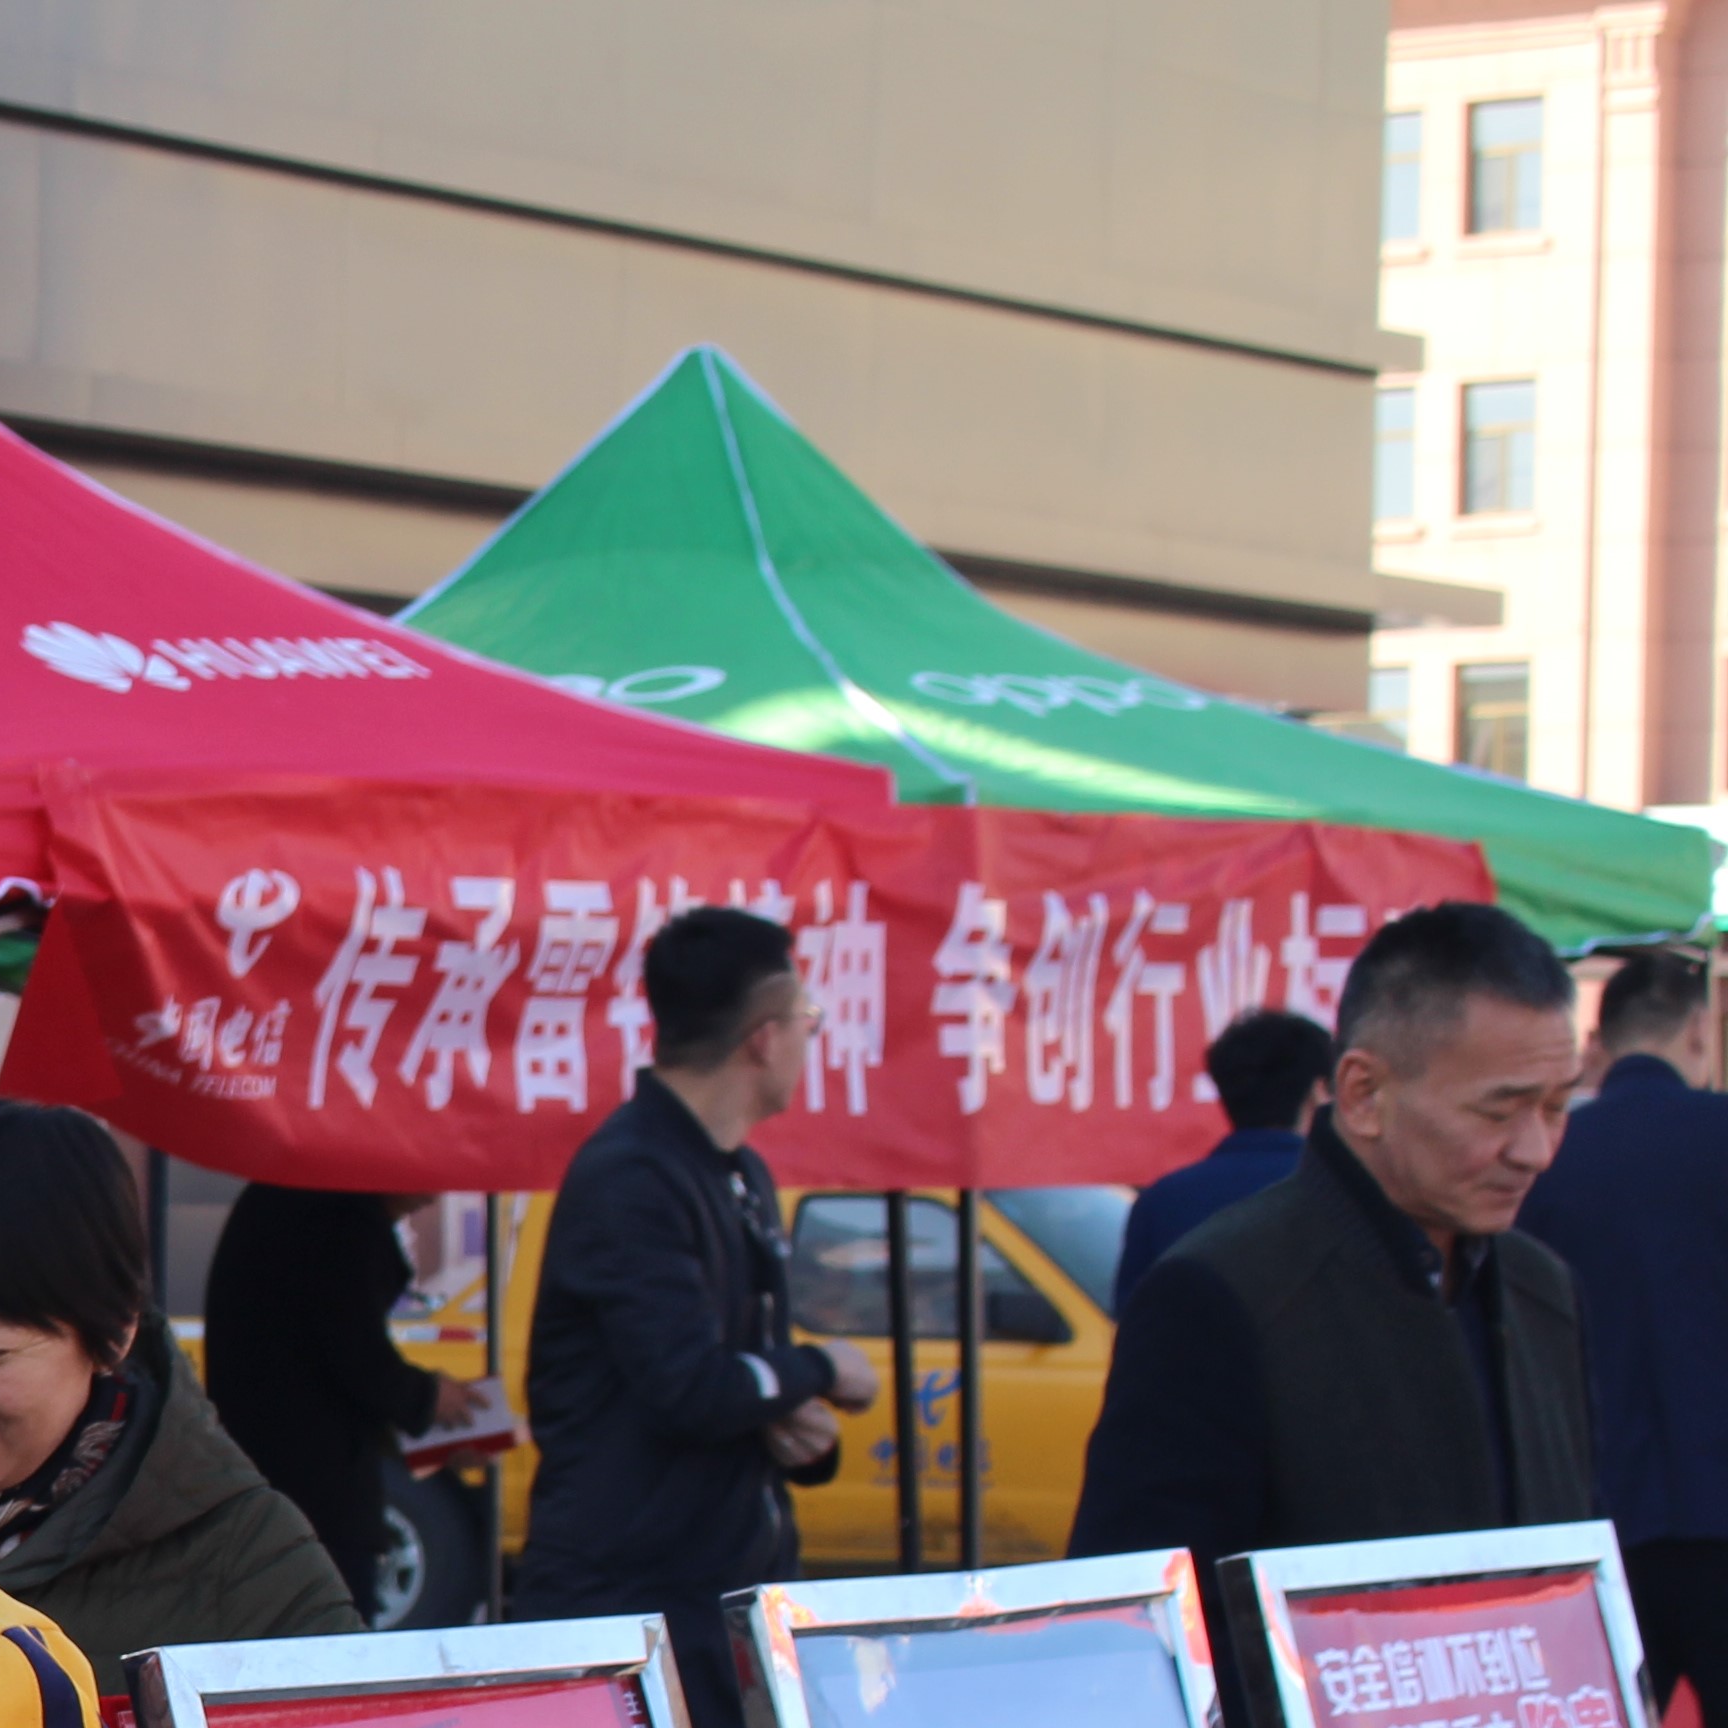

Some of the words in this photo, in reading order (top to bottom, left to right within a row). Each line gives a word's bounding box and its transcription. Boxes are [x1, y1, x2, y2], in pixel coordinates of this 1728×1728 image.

[177, 638, 431, 680] HUAWEI
[931, 881, 1402, 1113] 争创行业标
